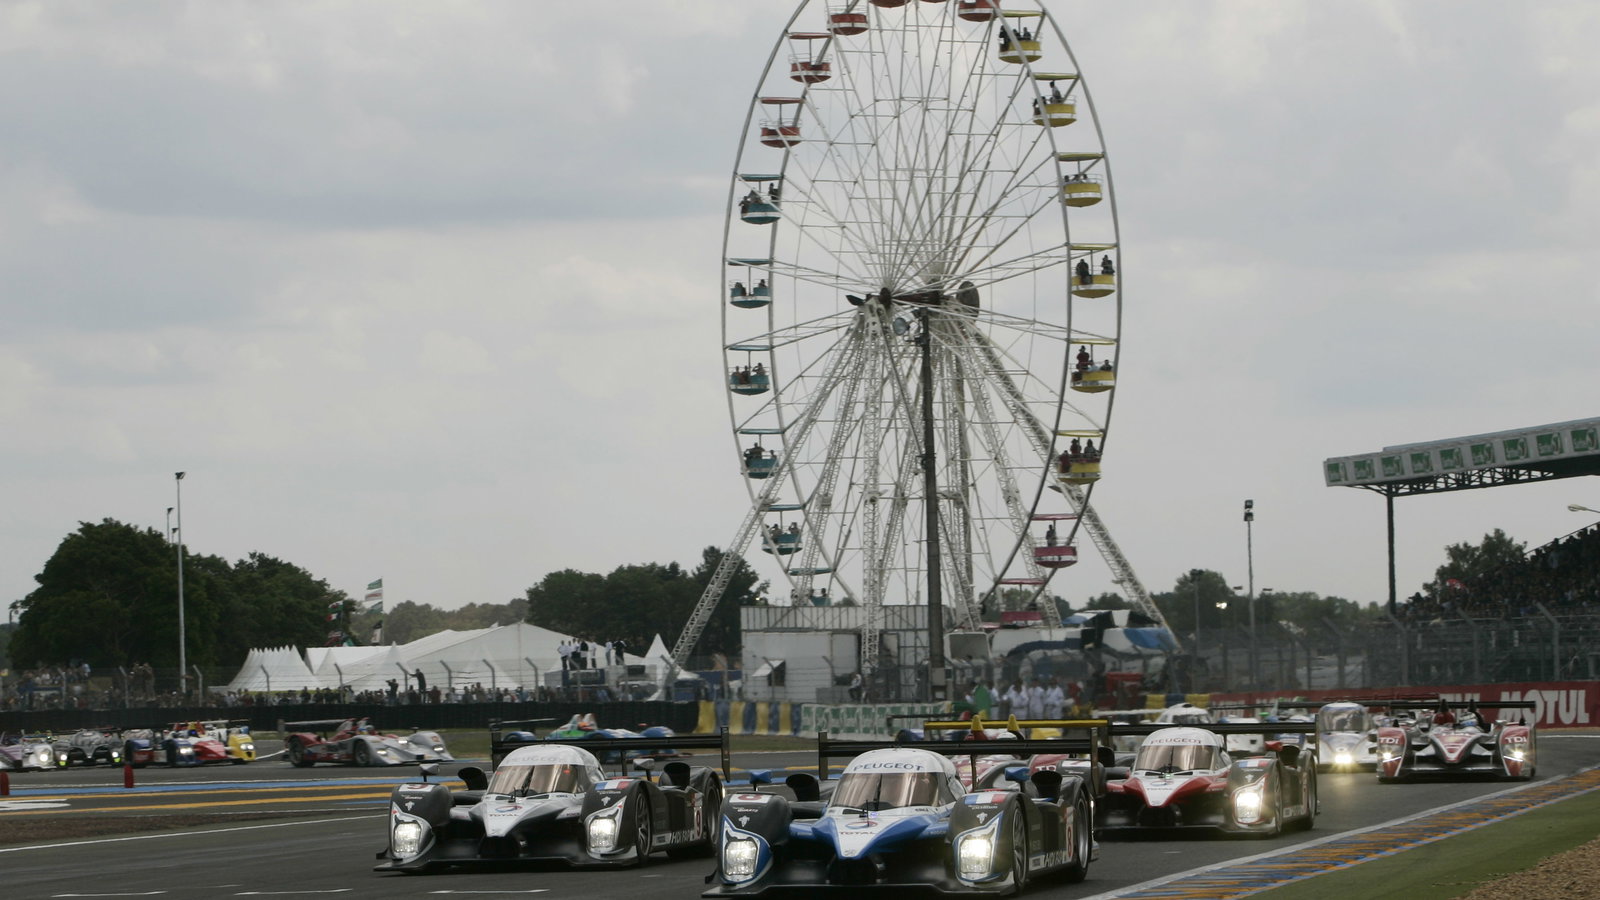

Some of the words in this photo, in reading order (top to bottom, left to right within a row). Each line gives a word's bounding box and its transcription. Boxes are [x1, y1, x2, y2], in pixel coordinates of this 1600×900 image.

[1498, 689, 1589, 725] MOTUL
[1150, 737, 1202, 745] PEUGEOT
[1379, 736, 1400, 745] TDI
[1504, 736, 1528, 744] TDI
[853, 762, 924, 772] PEUGEOT
[695, 809, 701, 838] 9
[1067, 825, 1072, 857] 8
